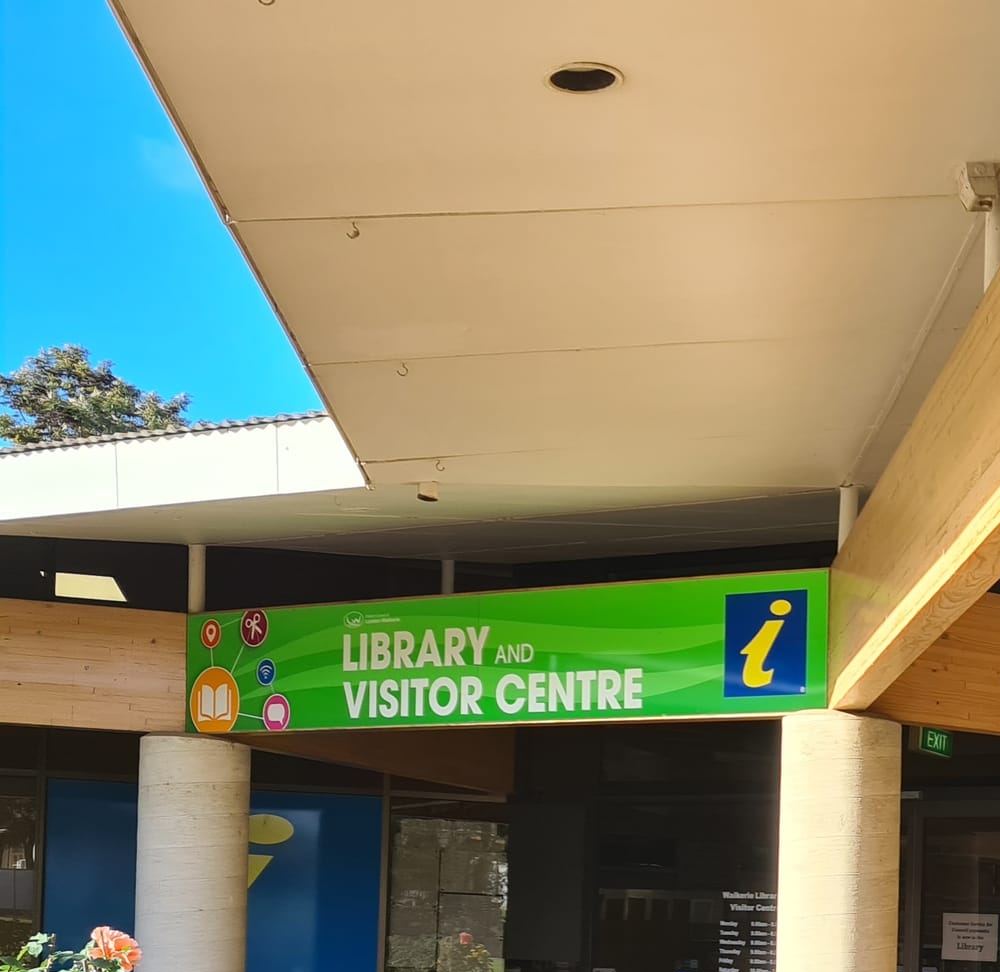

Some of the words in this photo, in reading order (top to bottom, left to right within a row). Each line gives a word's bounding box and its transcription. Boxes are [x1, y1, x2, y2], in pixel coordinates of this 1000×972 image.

[343, 626, 490, 671] LIBRARY
[494, 643, 534, 664] AND
[343, 676, 483, 719] VISITOR
[495, 668, 643, 715] CENTRE
[927, 730, 948, 751] EXIT
[755, 891, 777, 899] Librar
[730, 903, 754, 911] Visitor
[756, 903, 776, 911] Centr
[957, 942, 984, 952] Library
